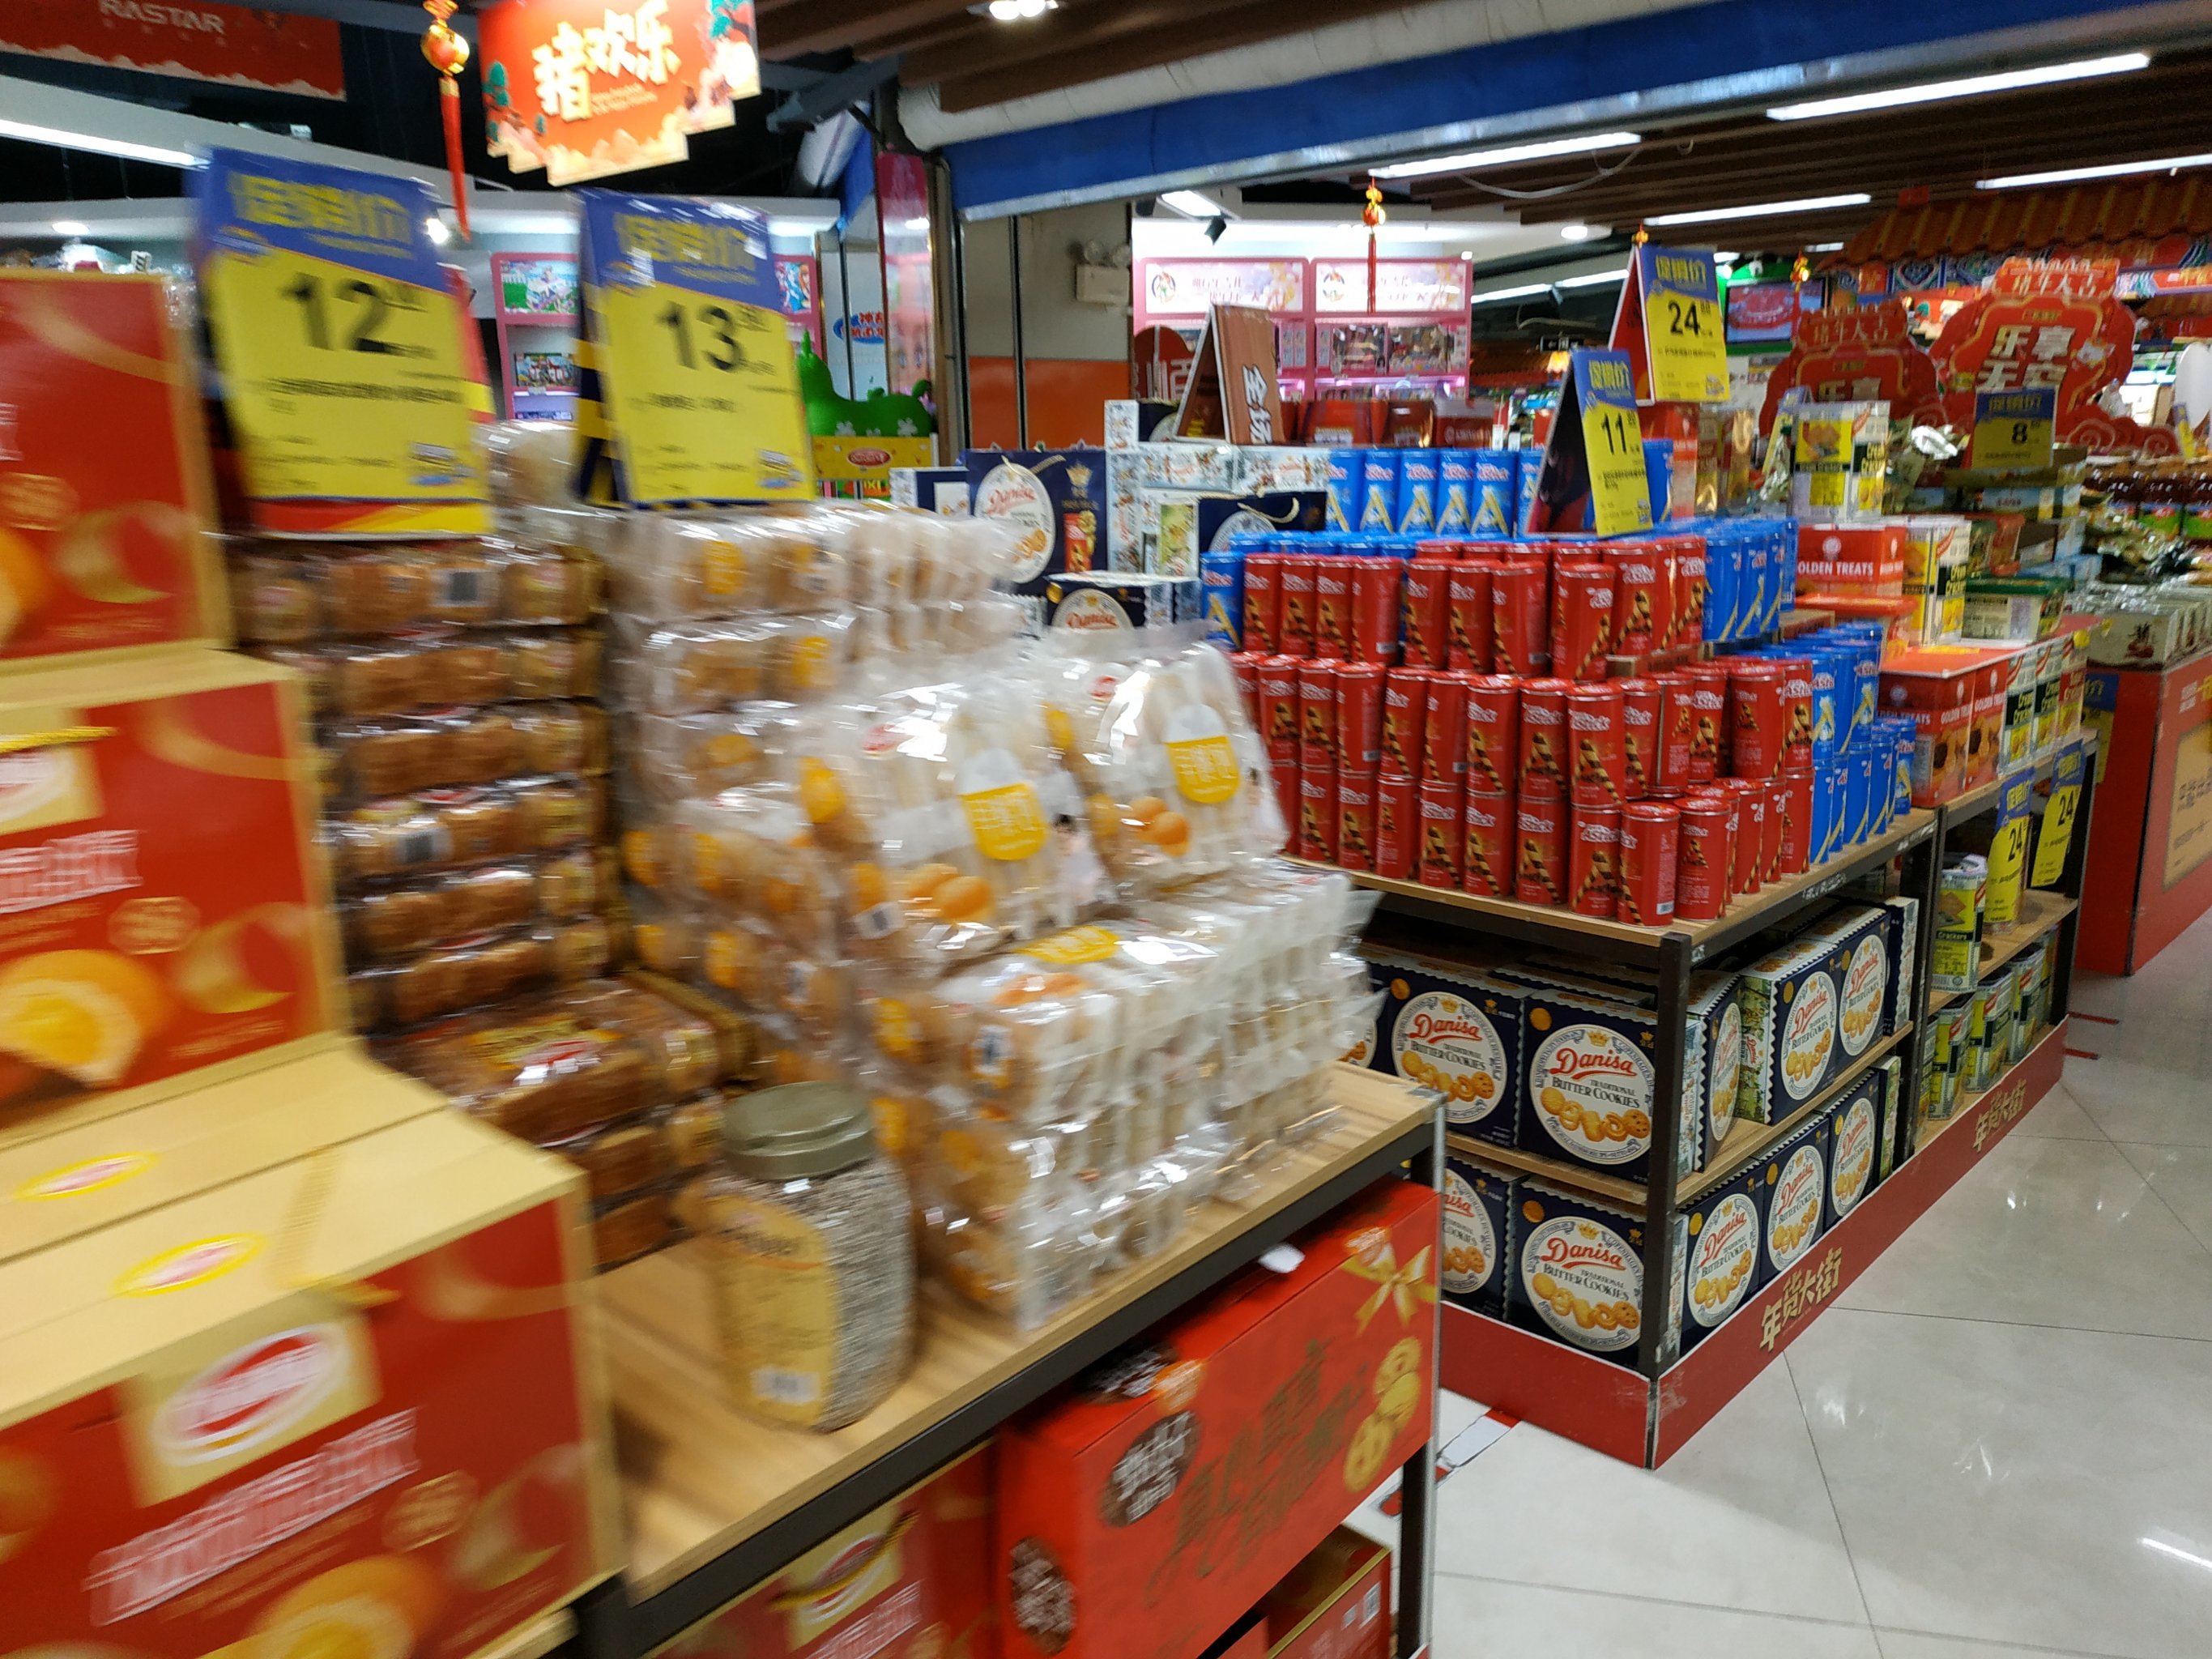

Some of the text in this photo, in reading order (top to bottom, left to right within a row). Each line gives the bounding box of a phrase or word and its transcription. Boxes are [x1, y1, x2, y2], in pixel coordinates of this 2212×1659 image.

[99, 0, 226, 34] RASTAR
[531, 0, 681, 122] 猪欢乐
[279, 272, 399, 355] 12
[1668, 300, 1700, 335] 24
[655, 301, 744, 373] 13
[1601, 412, 1626, 455] 11
[2011, 422, 2027, 443] 8
[1797, 561, 1833, 576] OLDEN
[1836, 561, 1873, 577] TREATS
[2057, 790, 2073, 826] 24
[2008, 822, 2022, 862] 24
[1408, 1013, 1482, 1043] Danisa
[1791, 990, 1828, 1039] Danisa
[1446, 1051, 1485, 1071] COOKIES
[1549, 1047, 1637, 1079] Danisa
[1553, 1077, 1639, 1108] BUTTER COOKIES
[1591, 1080, 1635, 1096] TRADITIONAL
[1840, 1115, 1868, 1163] Danisa
[1444, 1190, 1475, 1218] nisa
[1778, 1162, 1814, 1214] Danisa
[1540, 1237, 1626, 1270] Danisa
[1700, 1210, 1747, 1267] Danisa
[1701, 1243, 1748, 1277] BUTTER COOKIES
[1543, 1264, 1629, 1302] BUTTER COOKIES
[1580, 1269, 1624, 1288] TRADITIONAL
[1759, 1247, 1843, 1353] 年货大街
